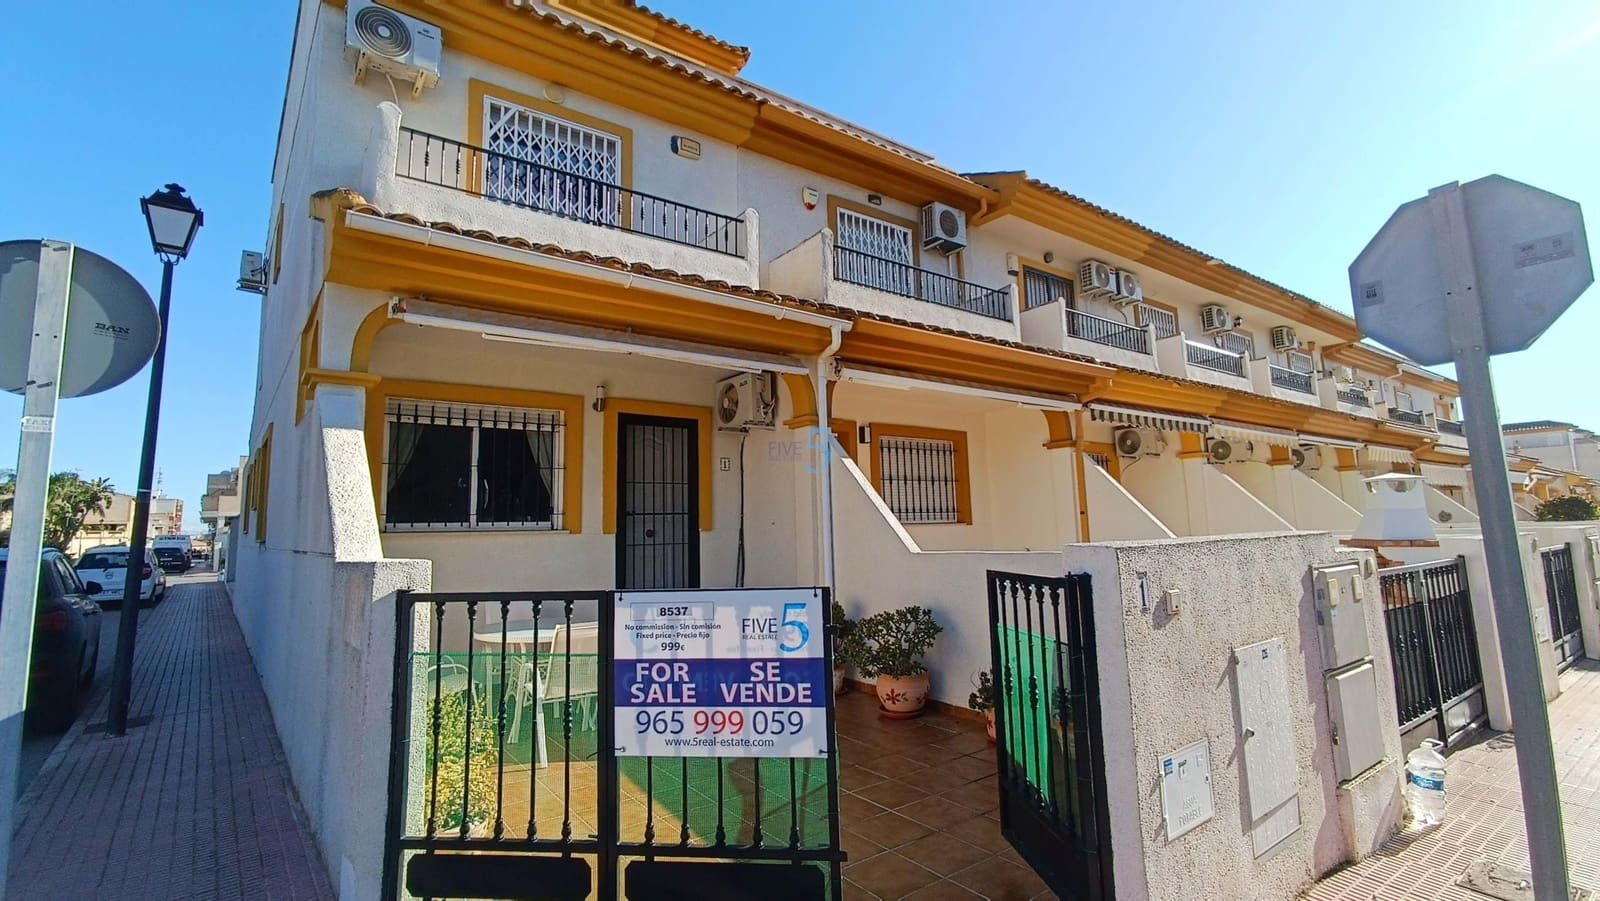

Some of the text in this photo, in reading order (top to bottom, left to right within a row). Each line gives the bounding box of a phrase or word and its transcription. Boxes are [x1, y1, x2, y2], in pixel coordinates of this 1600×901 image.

[660, 606, 689, 617] 8537
[635, 623, 675, 631] commission
[655, 632, 672, 640] price
[698, 631, 710, 640] fijo
[742, 602, 810, 653] FIVE 5
[636, 662, 690, 682] FOR
[750, 661, 781, 682] SE
[630, 683, 697, 704] SALE
[720, 682, 812, 704] VENDE
[635, 710, 804, 735] 965 999 059
[664, 737, 775, 748] www.5real-estate.com
